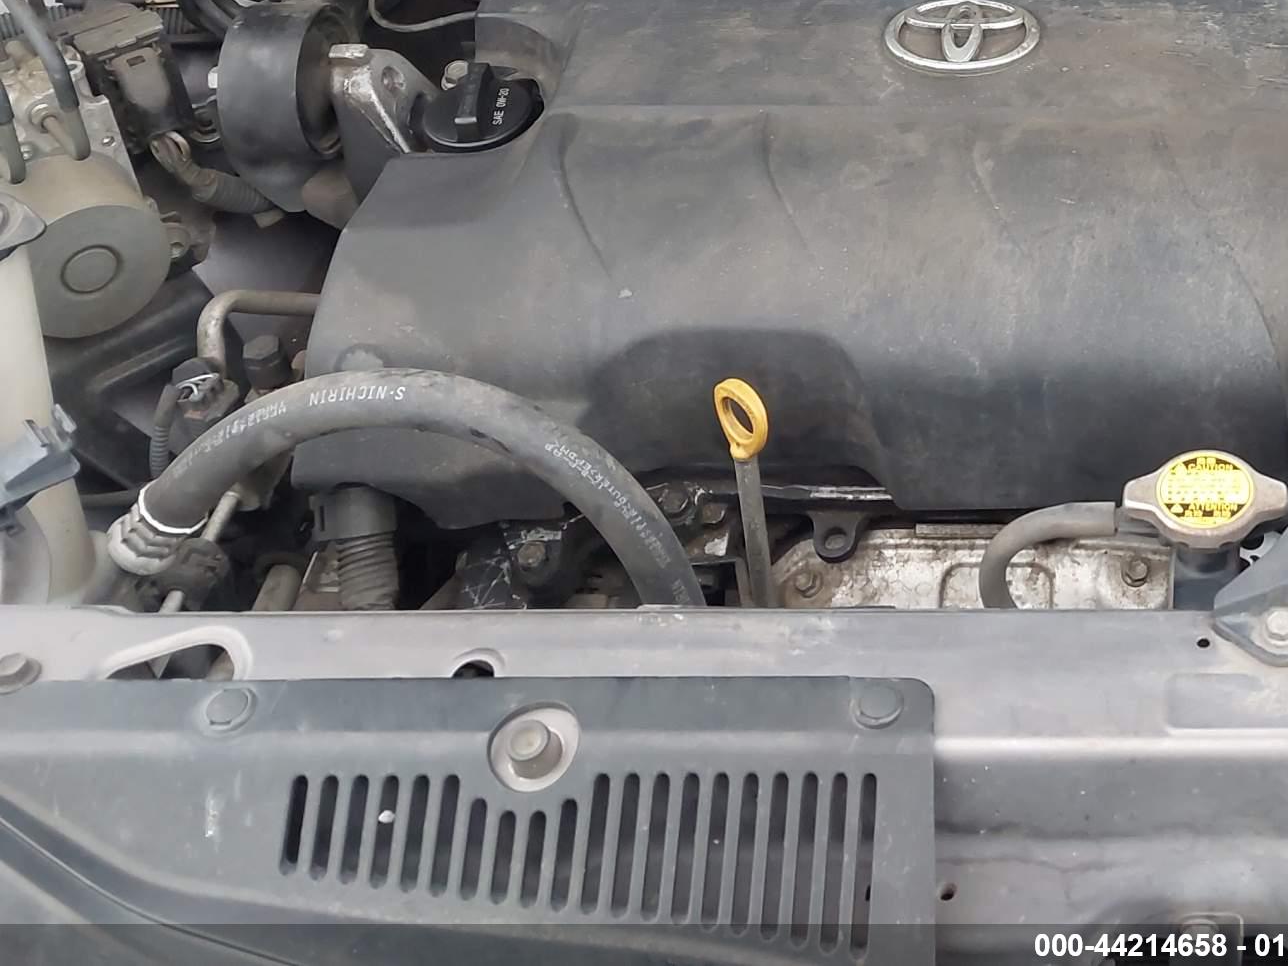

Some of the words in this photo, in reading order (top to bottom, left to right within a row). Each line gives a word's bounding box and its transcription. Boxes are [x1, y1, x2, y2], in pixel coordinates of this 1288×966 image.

[495, 88, 510, 108] 0W-20
[492, 110, 504, 125] SAE
[1187, 503, 1239, 511] ATTENTION
